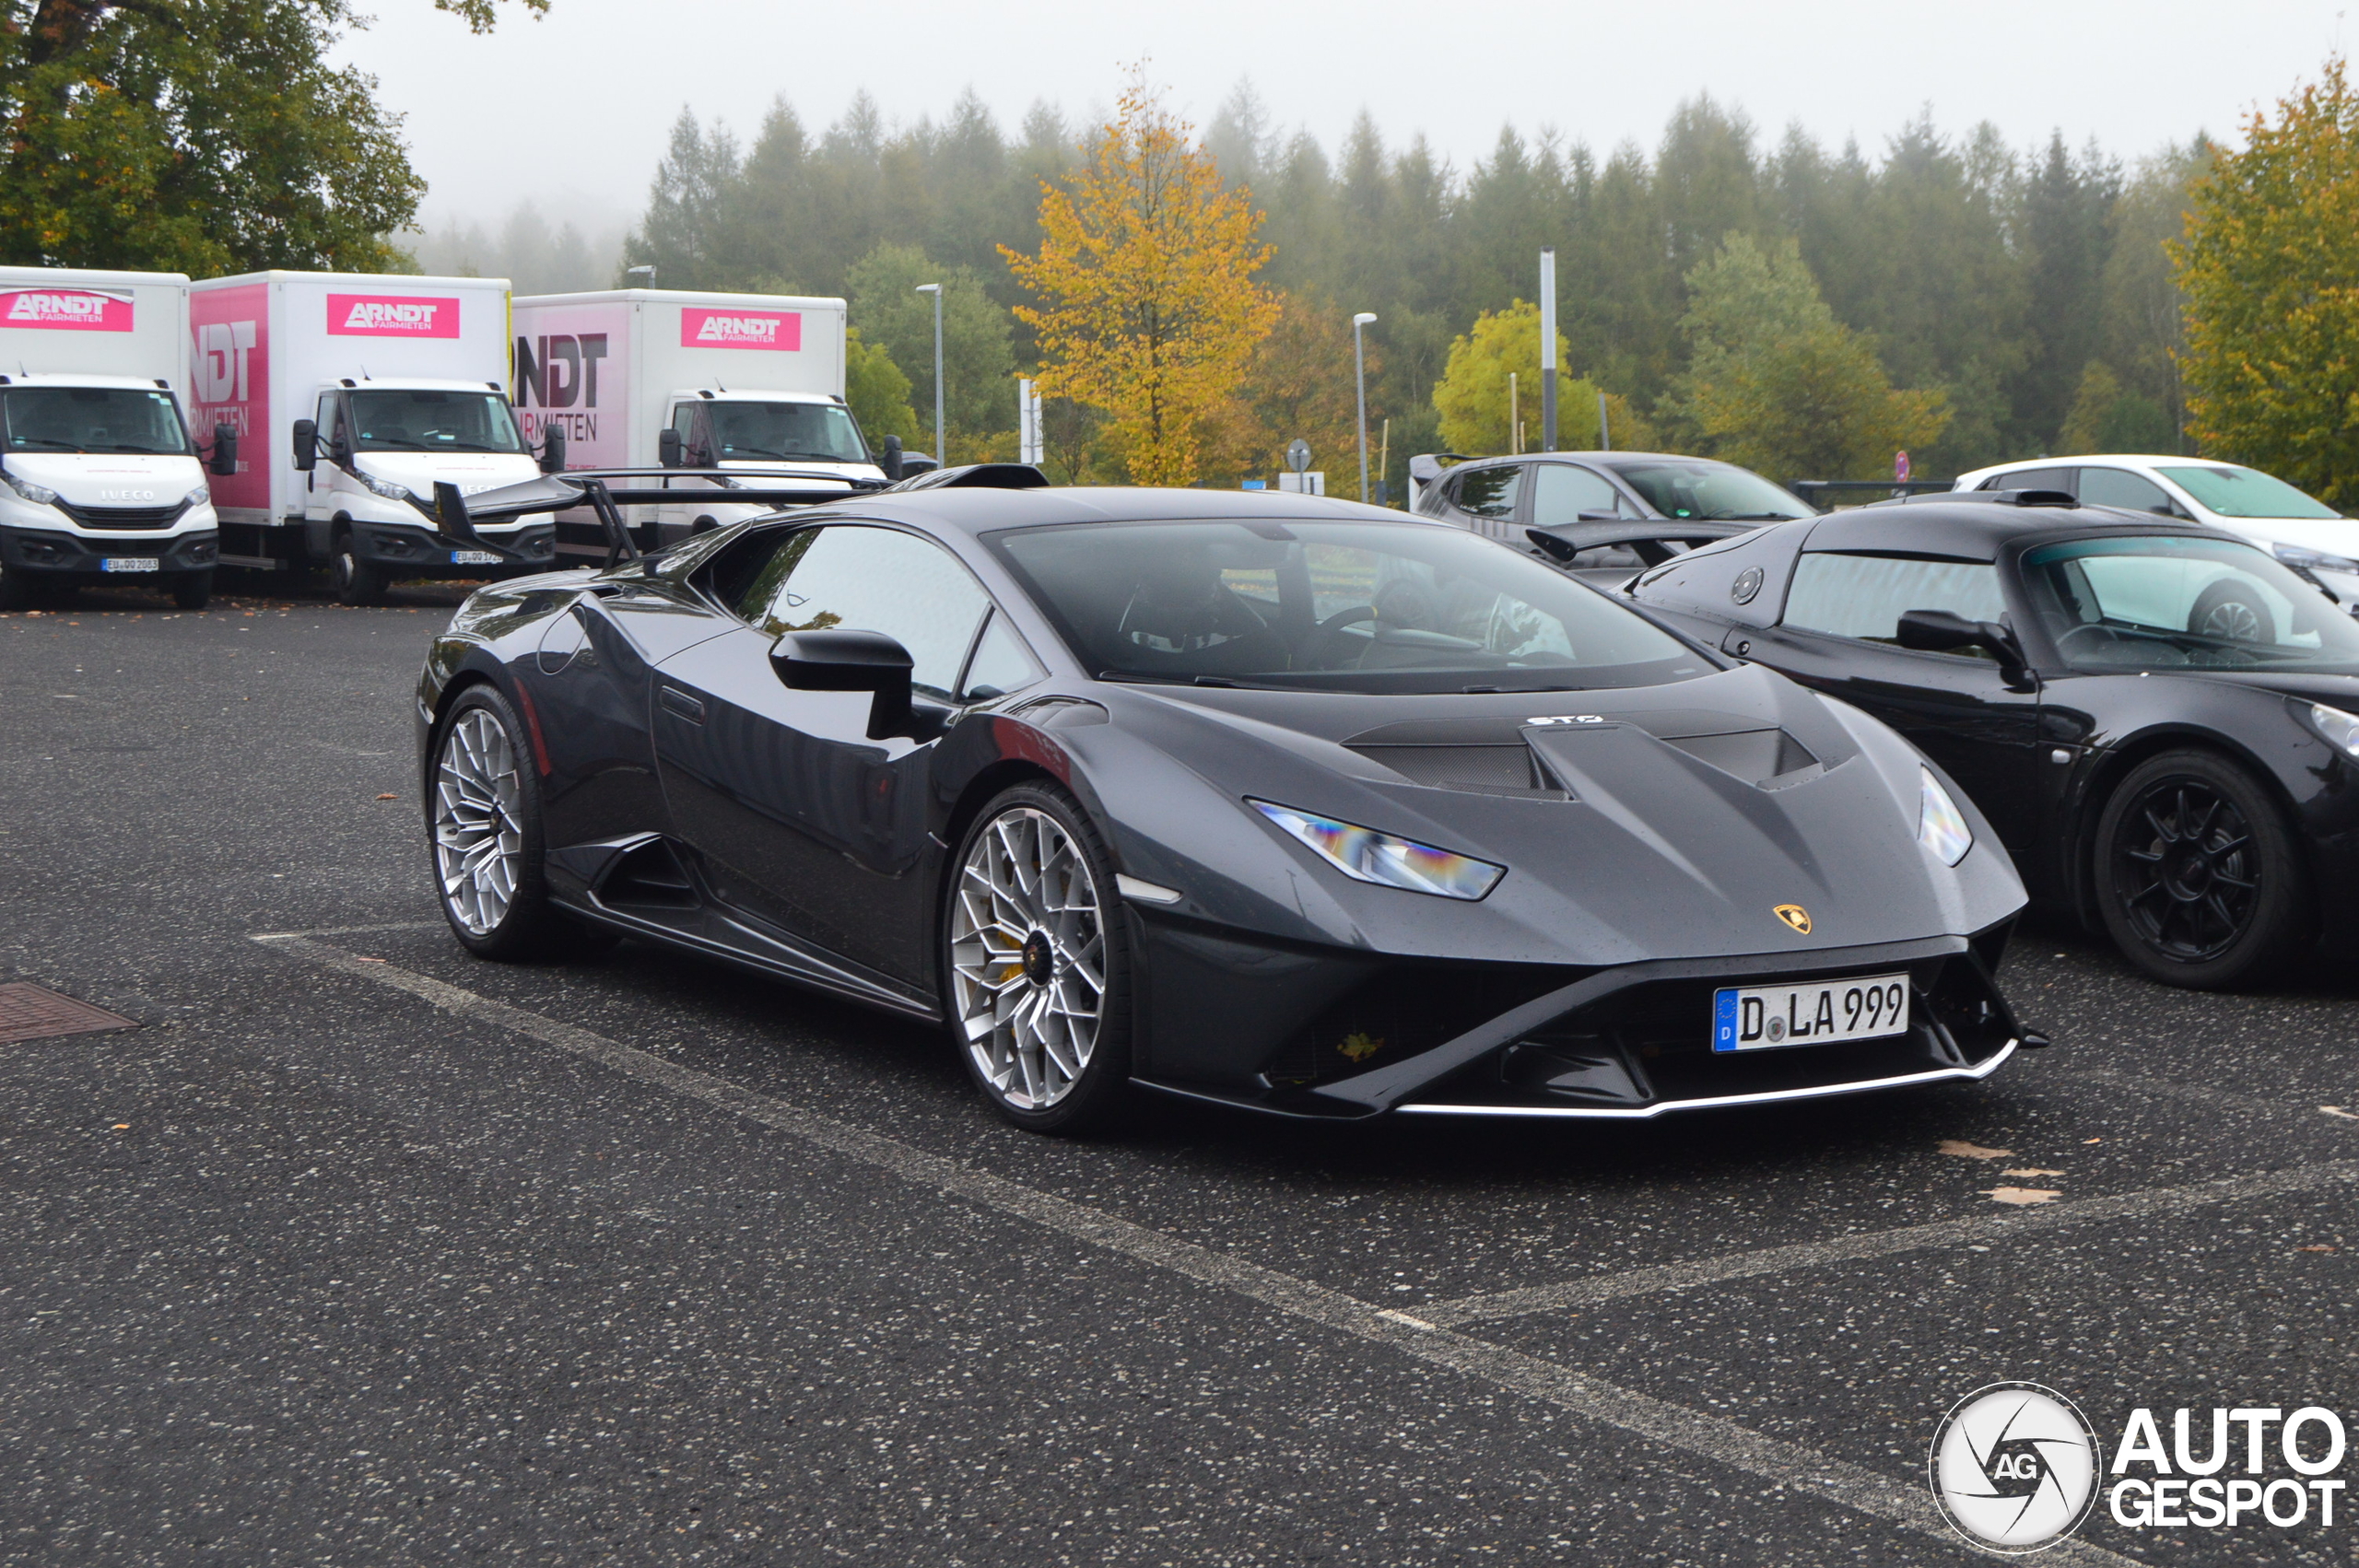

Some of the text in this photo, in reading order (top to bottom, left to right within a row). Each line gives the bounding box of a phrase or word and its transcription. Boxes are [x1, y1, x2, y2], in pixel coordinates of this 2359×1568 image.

[7, 294, 109, 321] ARNDT
[344, 302, 438, 328] ARNDT
[41, 313, 103, 322] FAIRMIETEN
[374, 320, 432, 330] FAIRMIETEN
[697, 316, 781, 341] ARNDT
[722, 333, 776, 343] FAIRMIETEN
[511, 333, 608, 408] NDT
[101, 489, 155, 501] IVECO
[1526, 715, 1604, 725] STO
[1741, 982, 1904, 1042] D LA 999
